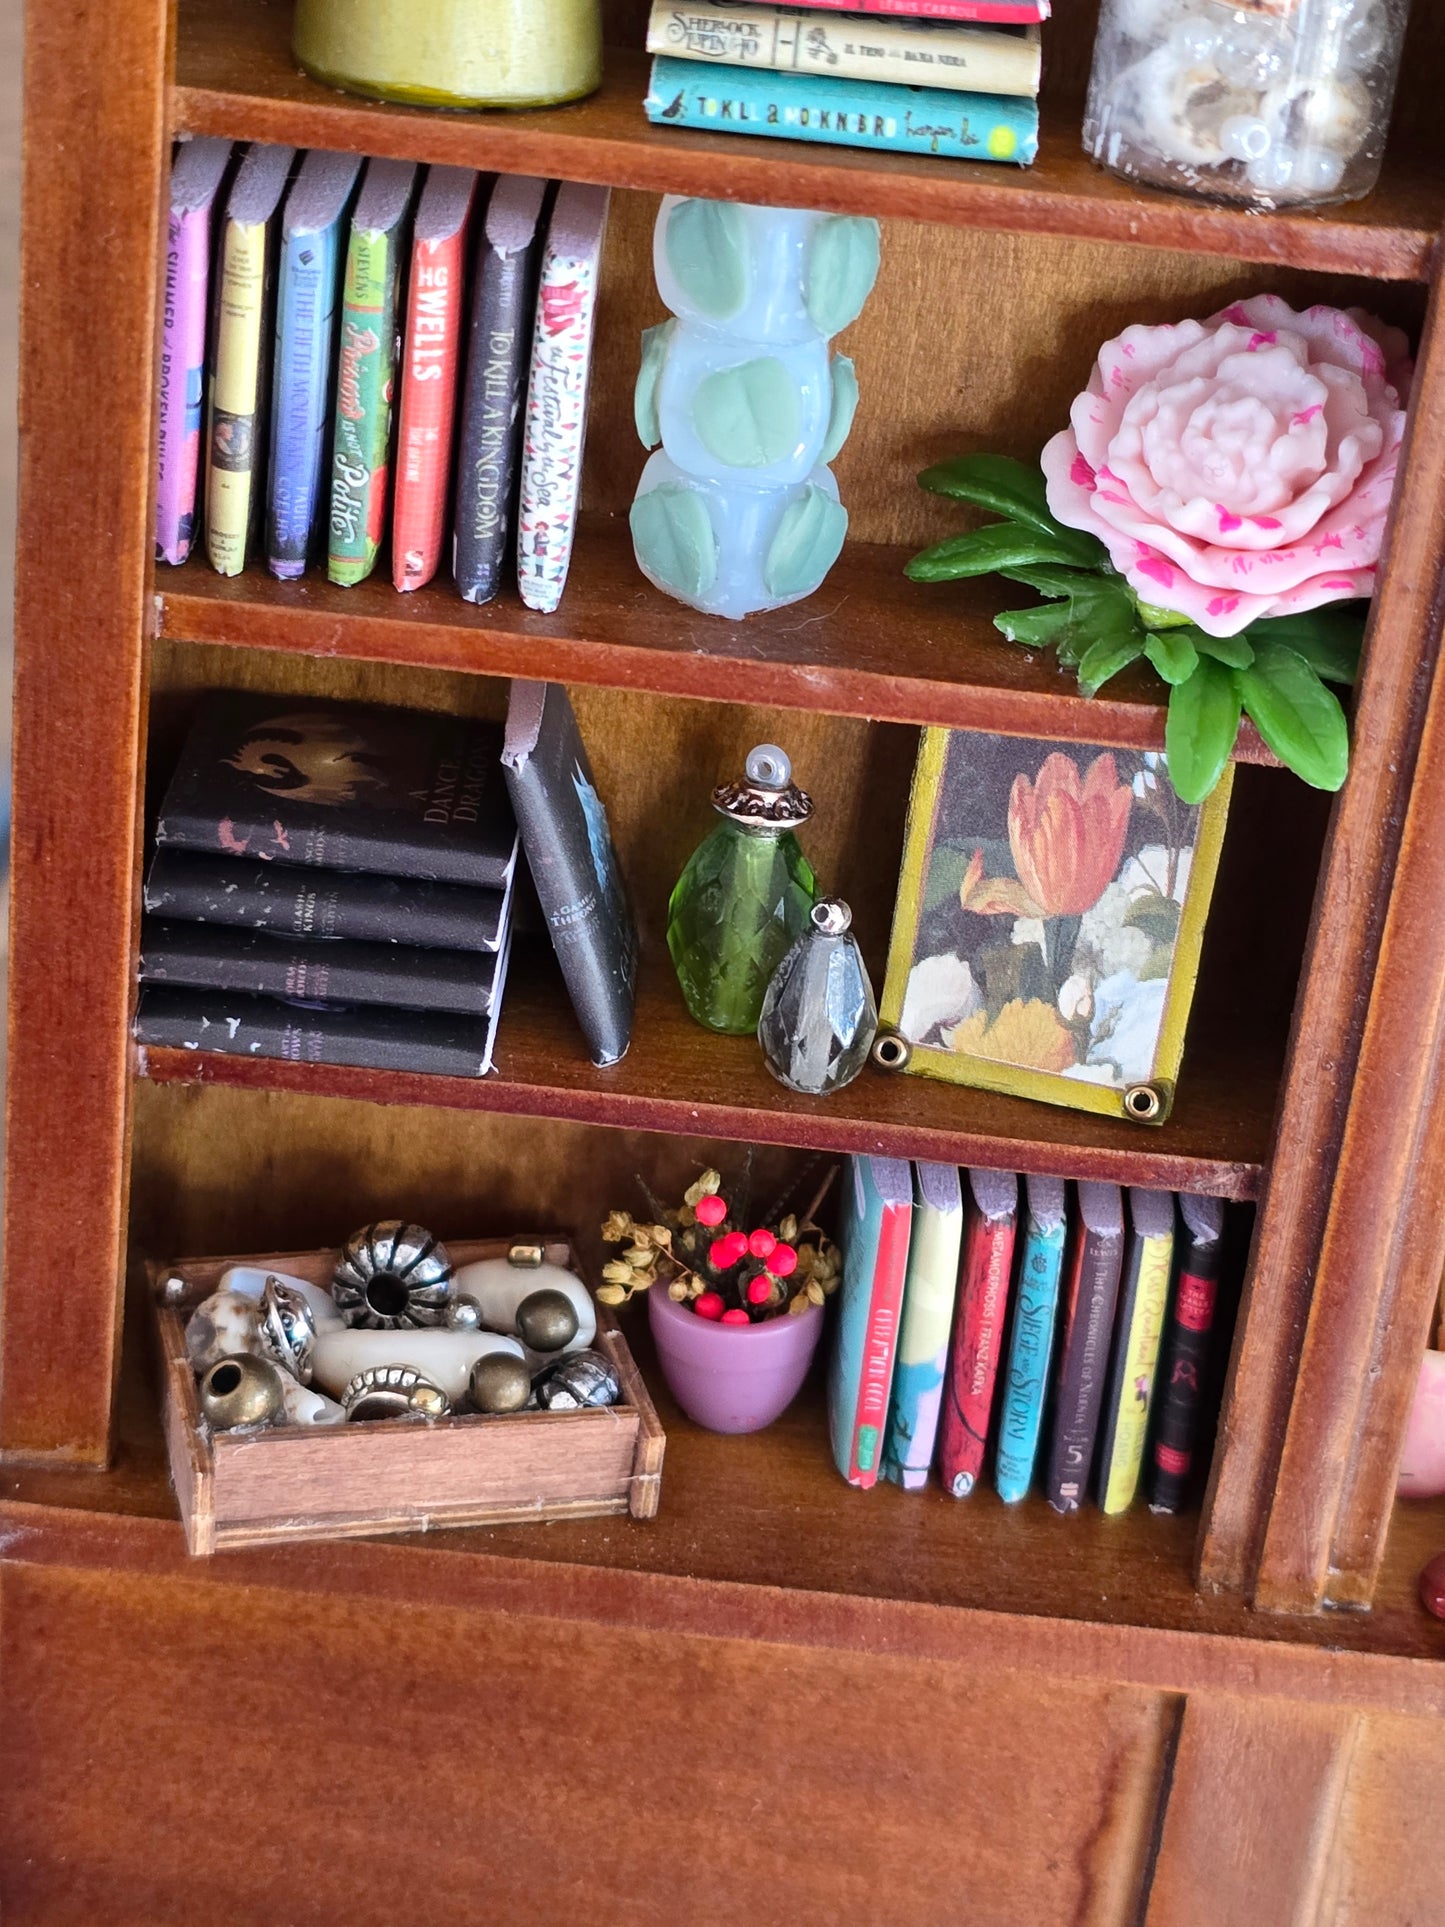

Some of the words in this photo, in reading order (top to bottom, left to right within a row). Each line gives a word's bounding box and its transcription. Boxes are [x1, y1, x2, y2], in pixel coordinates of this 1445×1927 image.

[355, 246, 371, 299] STEVENS
[418, 266, 448, 287] HG
[295, 290, 315, 323] THE
[292, 326, 314, 374] FIFTH
[412, 289, 448, 381] WELLS
[489, 328, 516, 355] TO
[483, 360, 513, 400] KILL
[538, 354, 570, 440] Festival
[482, 404, 505, 420] A
[331, 453, 370, 544] Polite
[474, 425, 507, 539] KINGDOM
[531, 471, 559, 509] Sea
[982, 1231, 1005, 1318] METAMORPHOSIS
[976, 1328, 993, 1360] FRANZ
[1019, 1294, 1051, 1356] SIEGE
[970, 1362, 988, 1396] KAFKA
[1007, 1368, 1041, 1441] STORM
